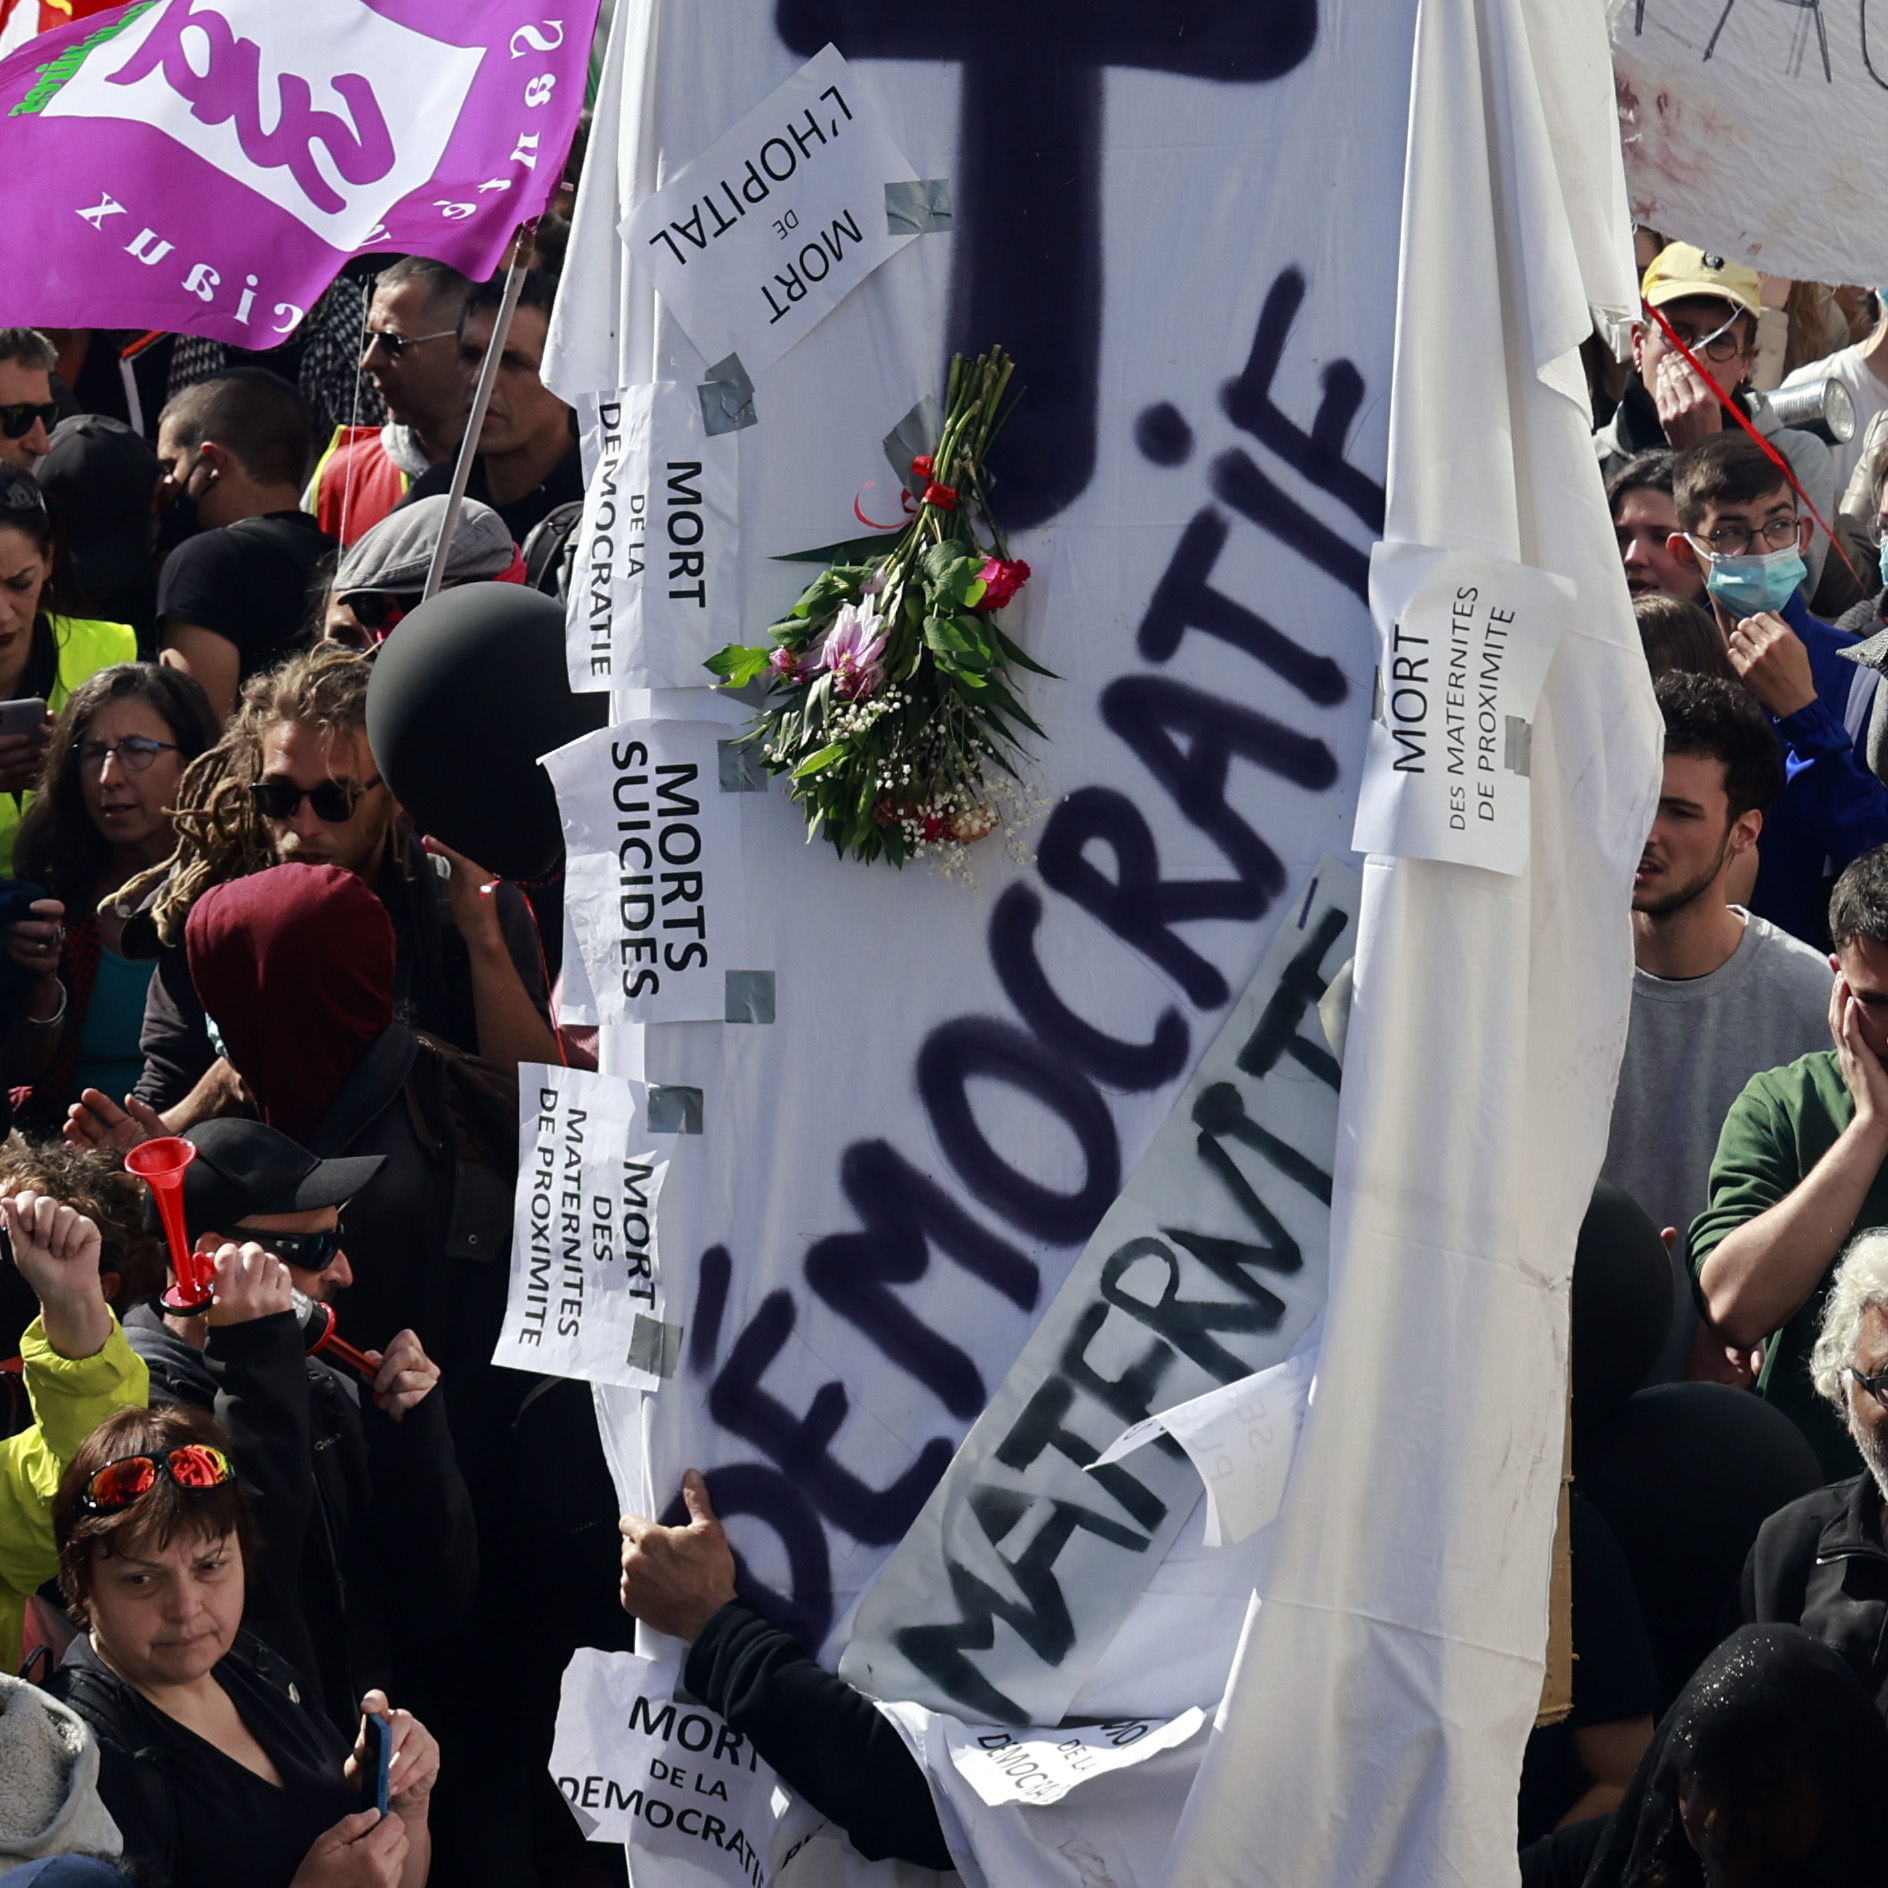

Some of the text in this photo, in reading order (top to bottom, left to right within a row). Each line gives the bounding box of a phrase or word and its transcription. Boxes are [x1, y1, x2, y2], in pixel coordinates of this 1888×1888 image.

[648, 85, 854, 266] L'HOPITAL
[771, 208, 800, 241] DE
[760, 208, 864, 325] MORT
[587, 402, 623, 677] DEMOCRATIE
[627, 493, 647, 579] DE LA
[666, 461, 707, 608] MORT
[1390, 623, 1430, 775] MORT
[1445, 586, 1479, 831] DES MATERNITES
[1477, 606, 1516, 822] DE PROXIMITE
[611, 741, 660, 999] SUICIDES
[654, 762, 708, 972] MORTS
[654, 265, 1387, 1653] DÉMOCRATIE
[518, 1087, 560, 1348] DE PROXIMITE
[557, 1108, 588, 1338] MATERNITES
[592, 1195, 614, 1262] DES
[622, 1160, 656, 1311] MORT
[649, 1758, 729, 1802] DE LA
